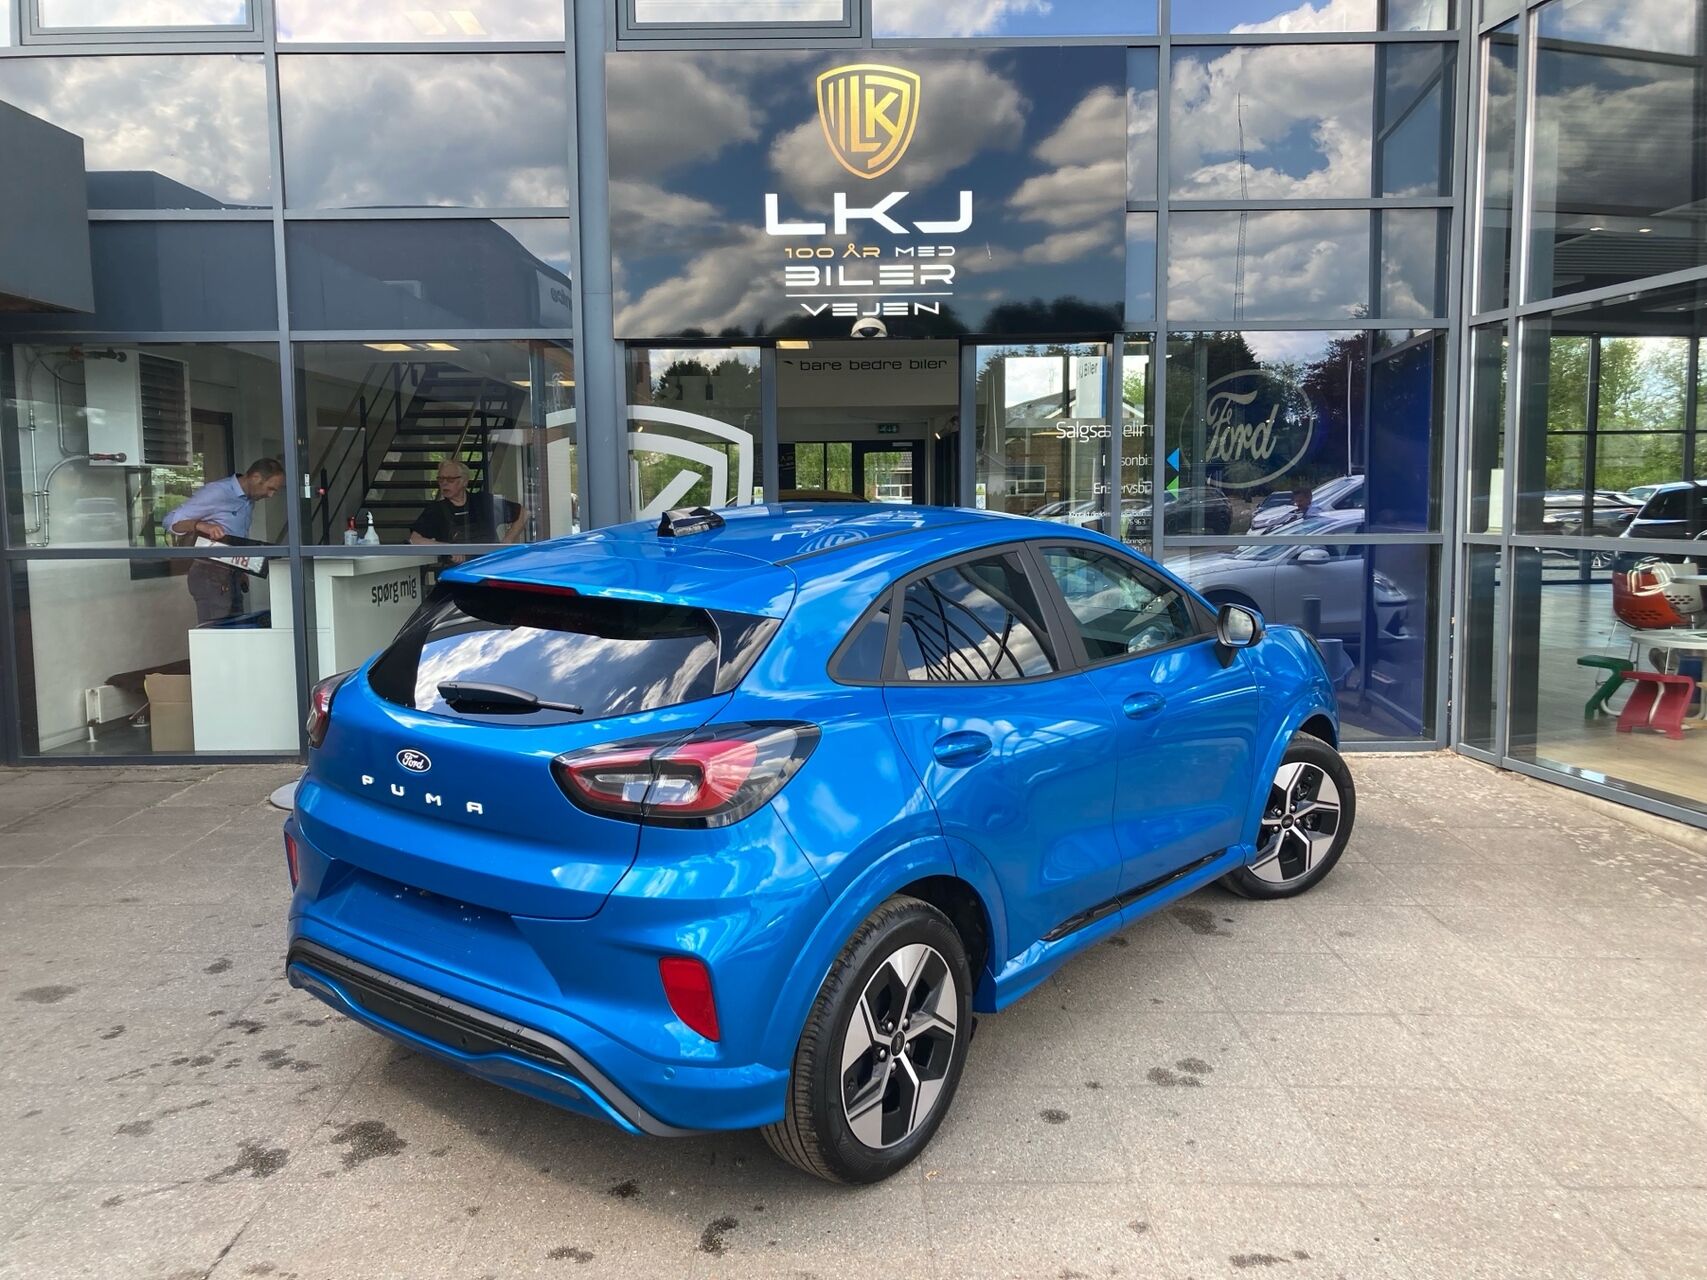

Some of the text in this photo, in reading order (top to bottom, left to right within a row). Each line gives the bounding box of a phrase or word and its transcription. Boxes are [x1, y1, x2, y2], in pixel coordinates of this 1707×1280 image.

[765, 190, 973, 235] LKJ
[785, 243, 956, 259] 100 ÅR MED
[785, 264, 956, 287] BILER
[800, 302, 940, 317] VEJEN
[800, 358, 947, 371] bare bedre biler
[1206, 390, 1279, 463] Ford
[371, 576, 417, 607] spørg mig
[401, 751, 425, 770] Ford
[361, 774, 484, 815] PUMA
